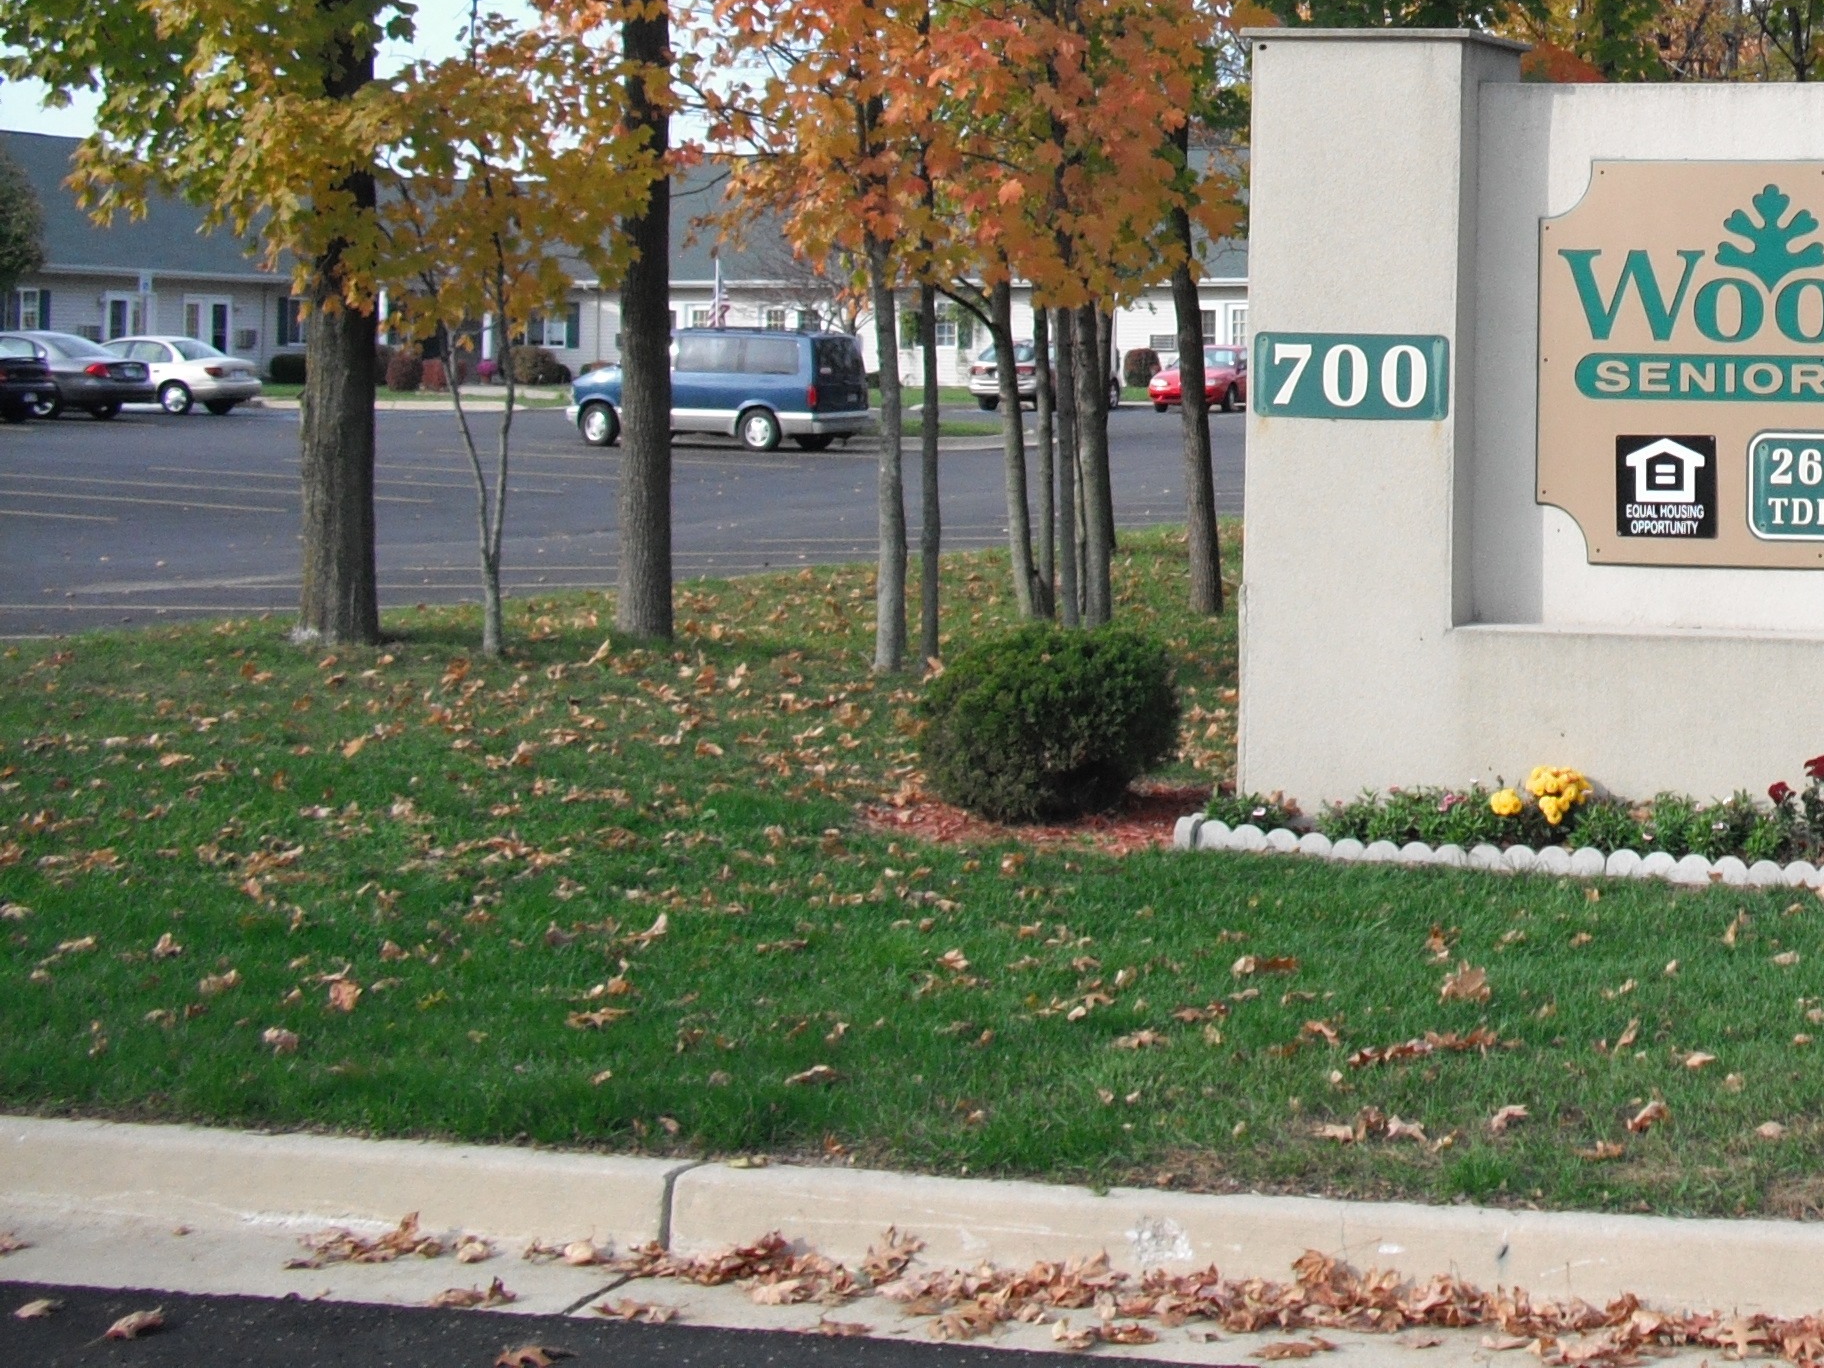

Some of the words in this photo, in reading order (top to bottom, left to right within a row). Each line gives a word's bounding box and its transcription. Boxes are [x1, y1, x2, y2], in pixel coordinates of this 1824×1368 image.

[1272, 342, 1428, 409] 700
[1625, 503, 1659, 519] EQUAL
[1660, 504, 1705, 520] HOUSING
[1630, 519, 1699, 535] OPPORTUNITY
